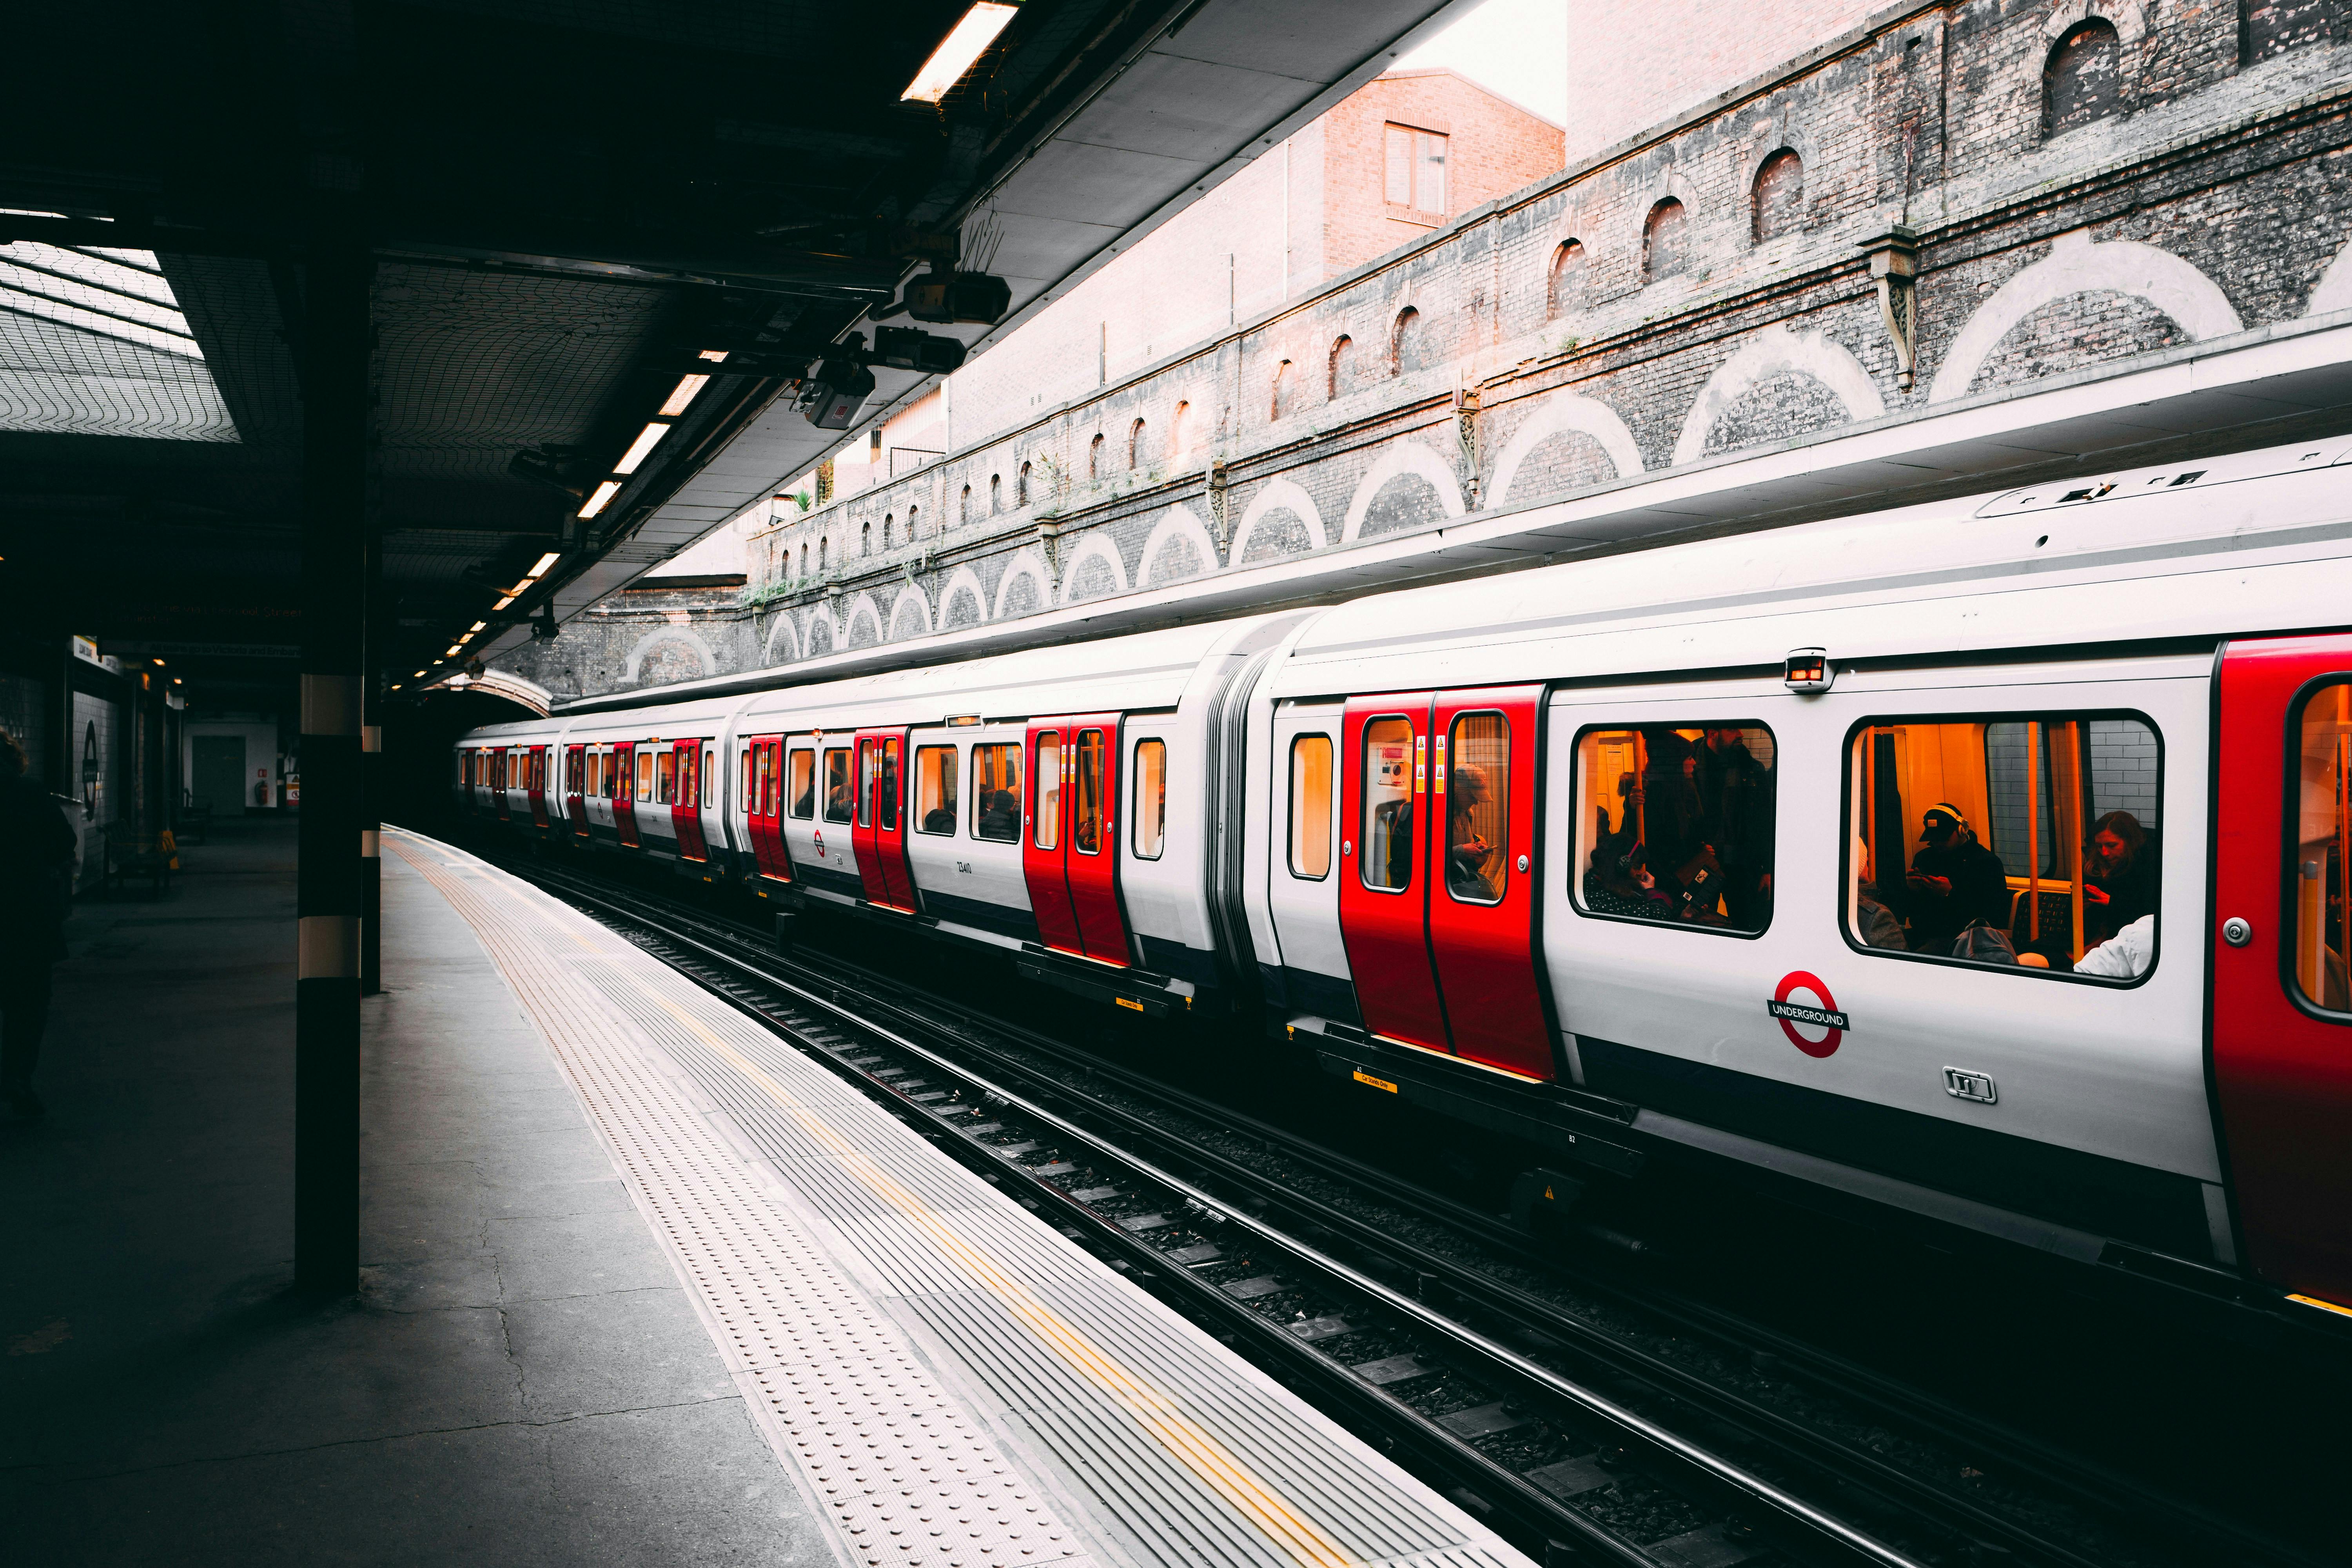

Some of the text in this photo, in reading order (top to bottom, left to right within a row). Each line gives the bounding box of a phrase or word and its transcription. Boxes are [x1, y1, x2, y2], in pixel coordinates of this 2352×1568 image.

[212, 645, 247, 654] Victoria
[250, 646, 265, 655] and
[957, 861, 971, 874] 23410
[1773, 1004, 1843, 1026] UNDERGROUND
[1368, 1077, 1379, 1085] Stands
[1569, 1135, 1575, 1143] B2
